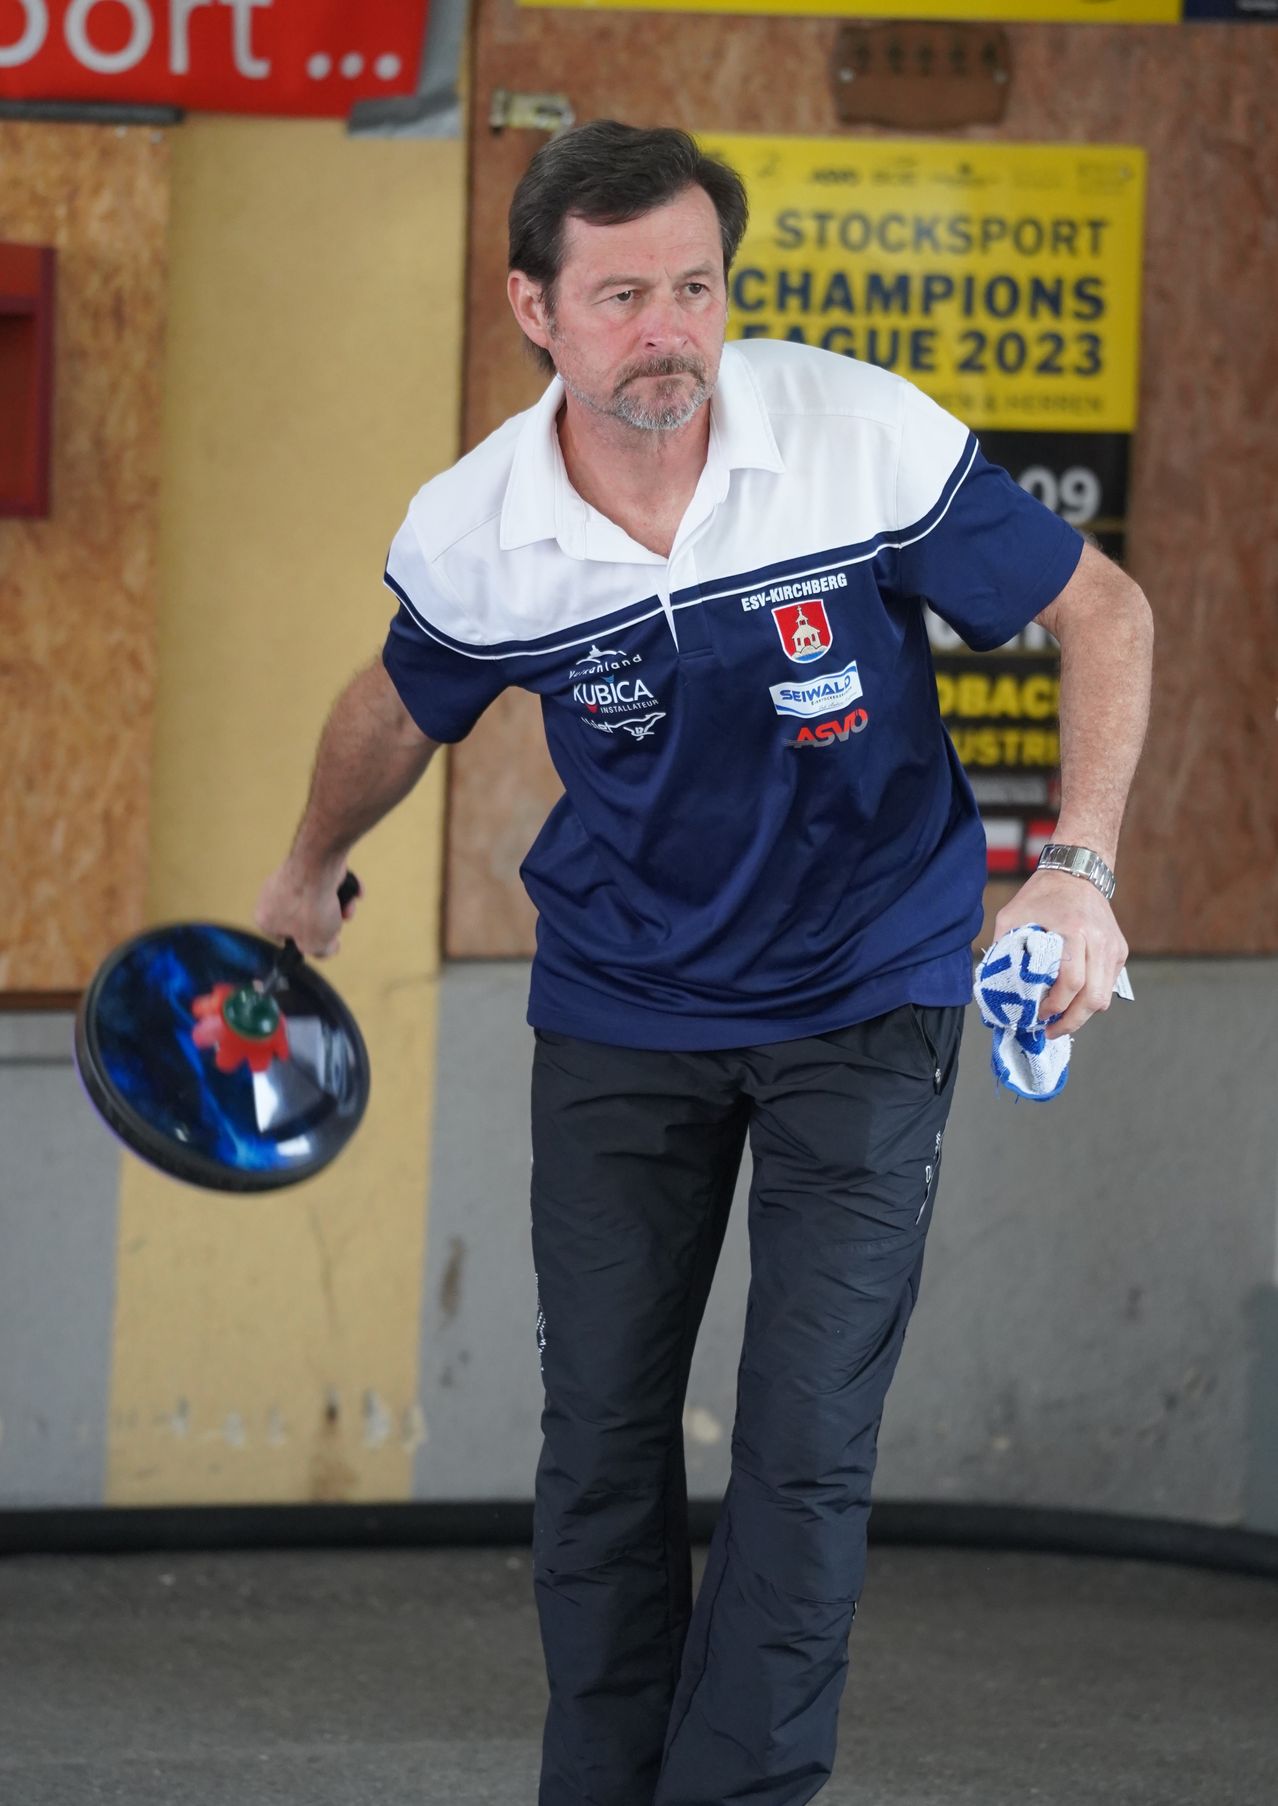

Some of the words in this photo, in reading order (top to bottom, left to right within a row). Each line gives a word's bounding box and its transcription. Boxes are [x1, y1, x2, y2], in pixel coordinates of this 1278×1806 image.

[776, 211, 1109, 258] STOCKSPORT
[733, 268, 1106, 321] CHAMPIONS
[957, 330, 1103, 377] 2023
[741, 573, 848, 612] ESV-KIRCHBERG
[573, 679, 654, 706] KUBICA
[600, 699, 659, 714] INSTALLATEUR
[780, 675, 851, 703] SEIWALD
